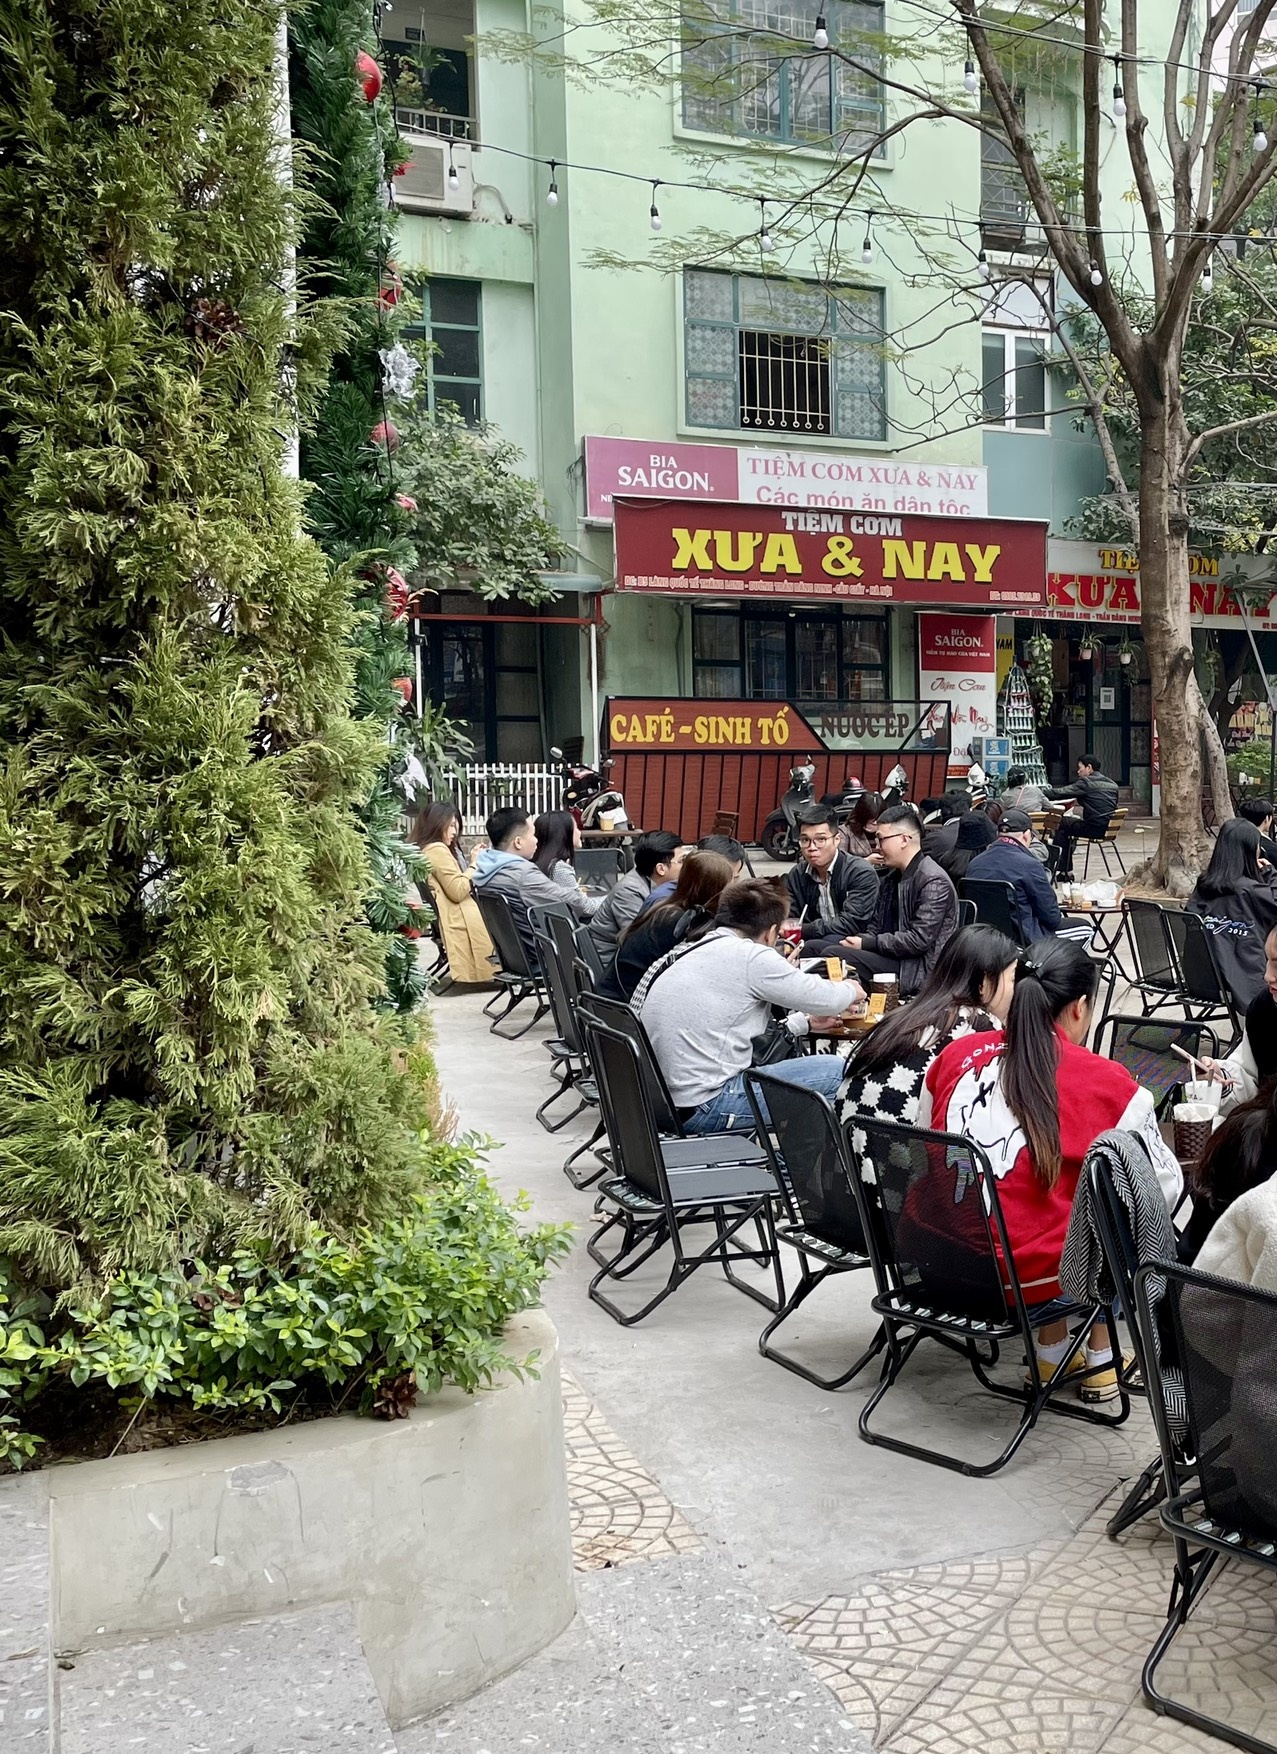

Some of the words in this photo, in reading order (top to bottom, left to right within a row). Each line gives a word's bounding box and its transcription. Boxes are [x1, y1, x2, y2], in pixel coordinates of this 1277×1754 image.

[650, 454, 678, 469] BIA
[747, 456, 806, 479] TIỆM
[811, 462, 863, 482] CƠM
[868, 465, 912, 486] XƯA
[916, 472, 932, 488] &
[937, 472, 979, 491] NAY
[618, 466, 710, 491] SAIGON
[756, 485, 800, 505] Các
[806, 487, 854, 509] món
[861, 493, 887, 510] ăn
[893, 494, 932, 513] dân
[781, 510, 844, 536] TIỆM
[850, 515, 903, 537] CƠM
[671, 527, 802, 574] XƯA
[821, 536, 864, 578] &
[882, 538, 1002, 583] NAY
[934, 634, 982, 648] SAIGON
[951, 628, 966, 636] BIA
[611, 707, 675, 744] CAFÉ
[693, 716, 752, 745] SINH
[757, 705, 790, 745] TỐ
[1228, 928, 1249, 936] 2015
